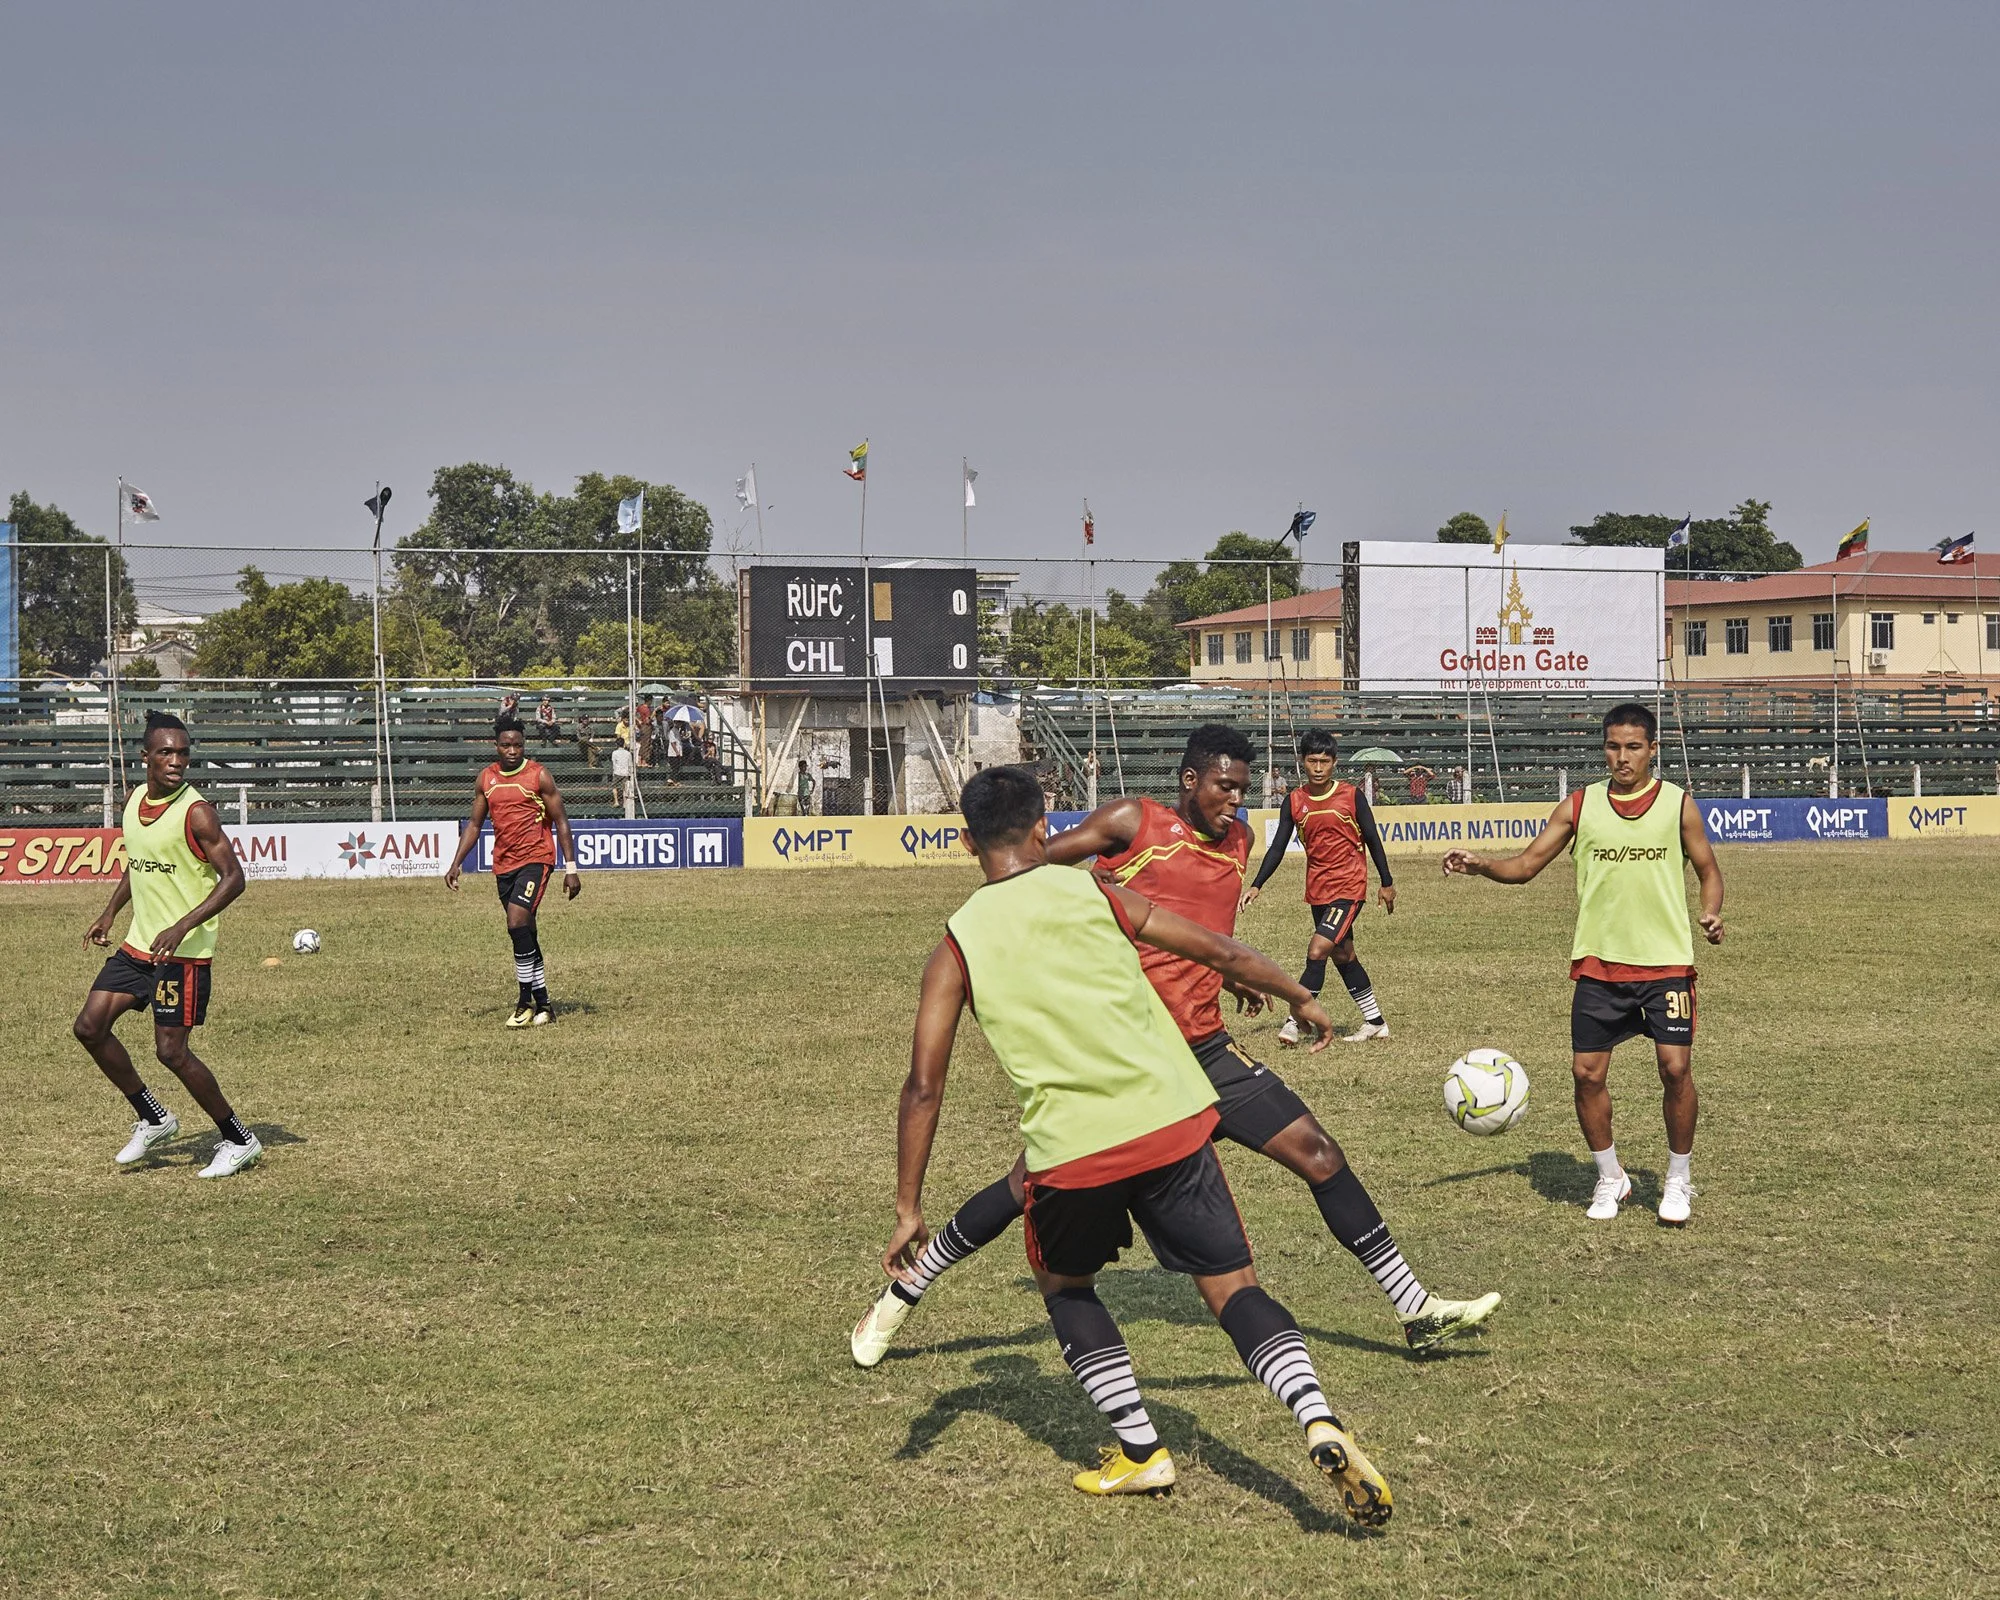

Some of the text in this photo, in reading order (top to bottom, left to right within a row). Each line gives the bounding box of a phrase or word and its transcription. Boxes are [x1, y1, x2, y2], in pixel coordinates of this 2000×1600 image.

[787, 583, 843, 617] RUFC
[952, 589, 968, 616] 0
[786, 640, 844, 673] CHL
[952, 643, 968, 670] 0
[1440, 648, 1589, 671] Golden Gate
[1375, 819, 1551, 842] YANMAR NATIONA
[18, 836, 130, 875] STAR
[231, 835, 287, 862] AMI
[380, 833, 440, 859] AMI
[578, 833, 675, 865] SPORTS
[1593, 845, 1667, 862] PRO//SPORT
[128, 857, 177, 875] RO//SPORT
[525, 881, 535, 898] 8
[1326, 906, 1344, 926] 11
[155, 980, 179, 1006] 45
[1665, 991, 1690, 1019] 30
